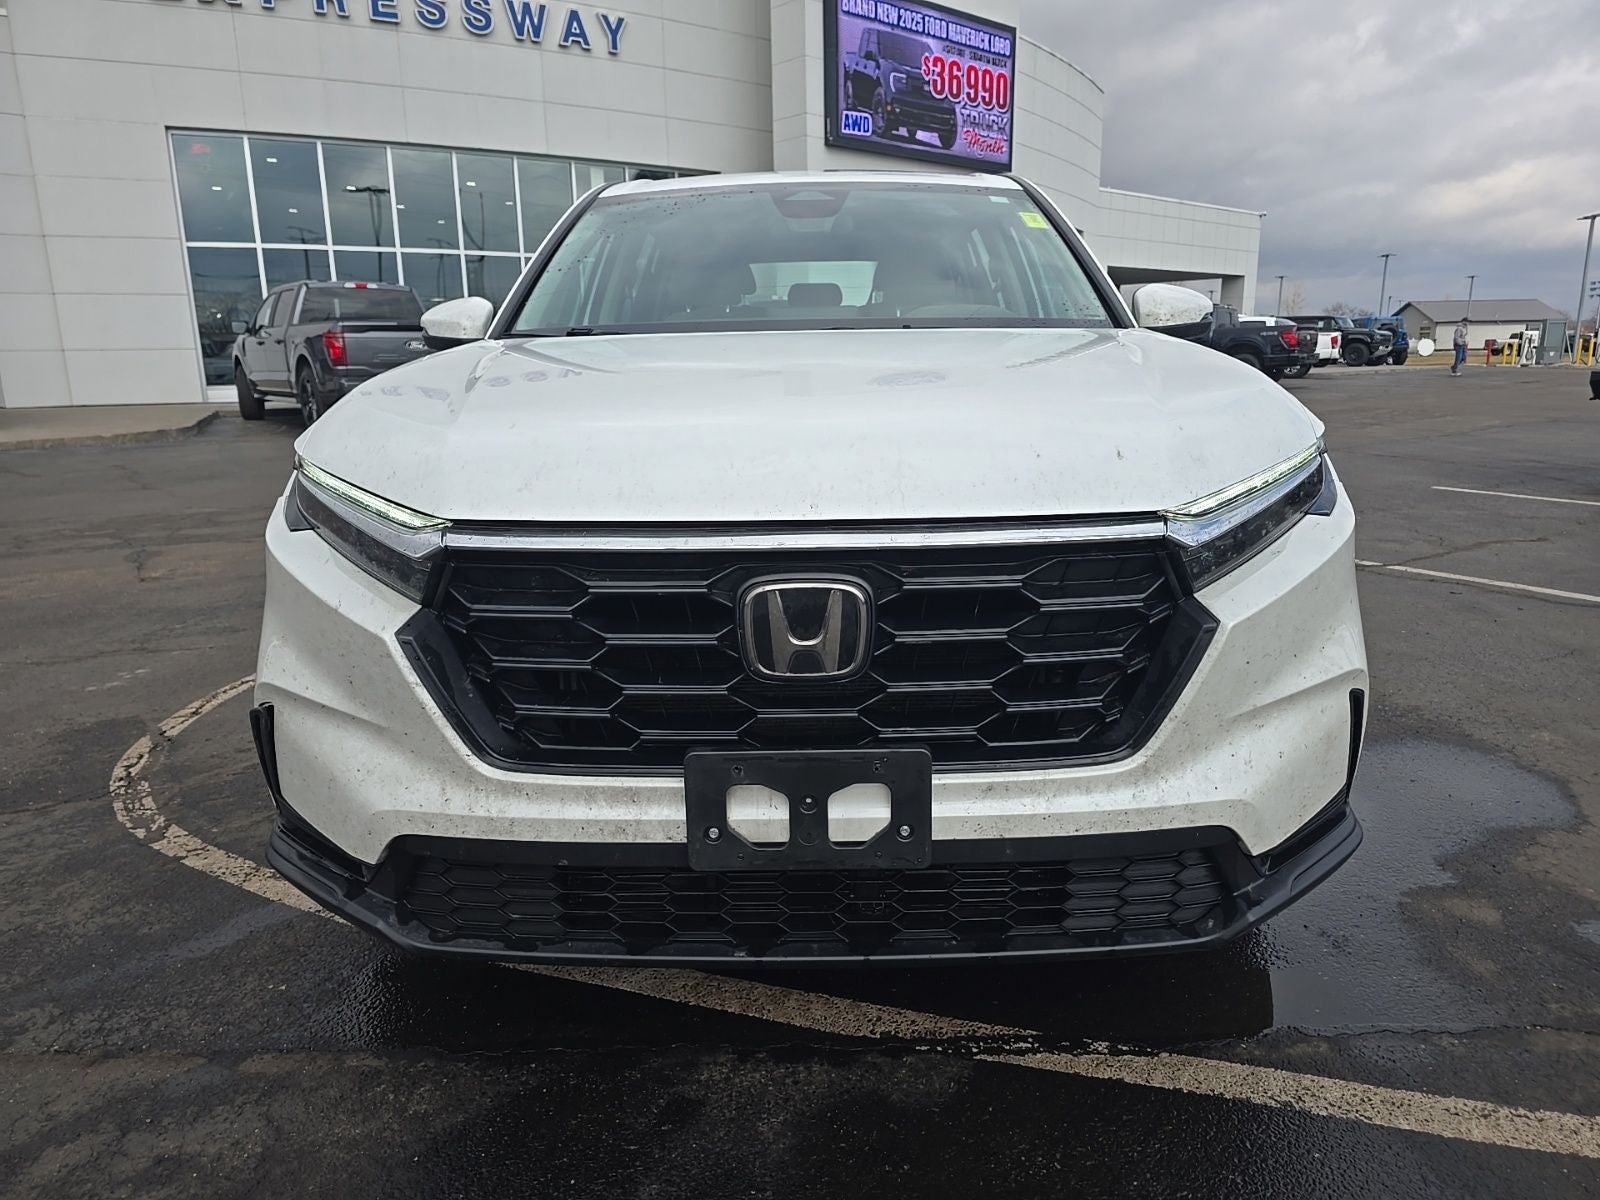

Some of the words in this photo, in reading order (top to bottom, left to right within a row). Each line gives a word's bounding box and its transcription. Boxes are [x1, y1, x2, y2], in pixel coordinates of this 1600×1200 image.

[185, 0, 626, 54] ESSWAY
[841, 0, 876, 18] BRAND
[876, 2, 898, 25] NEW
[899, 8, 923, 32] 2025
[924, 15, 947, 39] FORD
[947, 22, 990, 51] MAVERICK
[990, 34, 1011, 56] LOBO
[844, 113, 870, 133] AWD
[960, 108, 1008, 140] TRUCK
[963, 129, 1005, 154] Month
